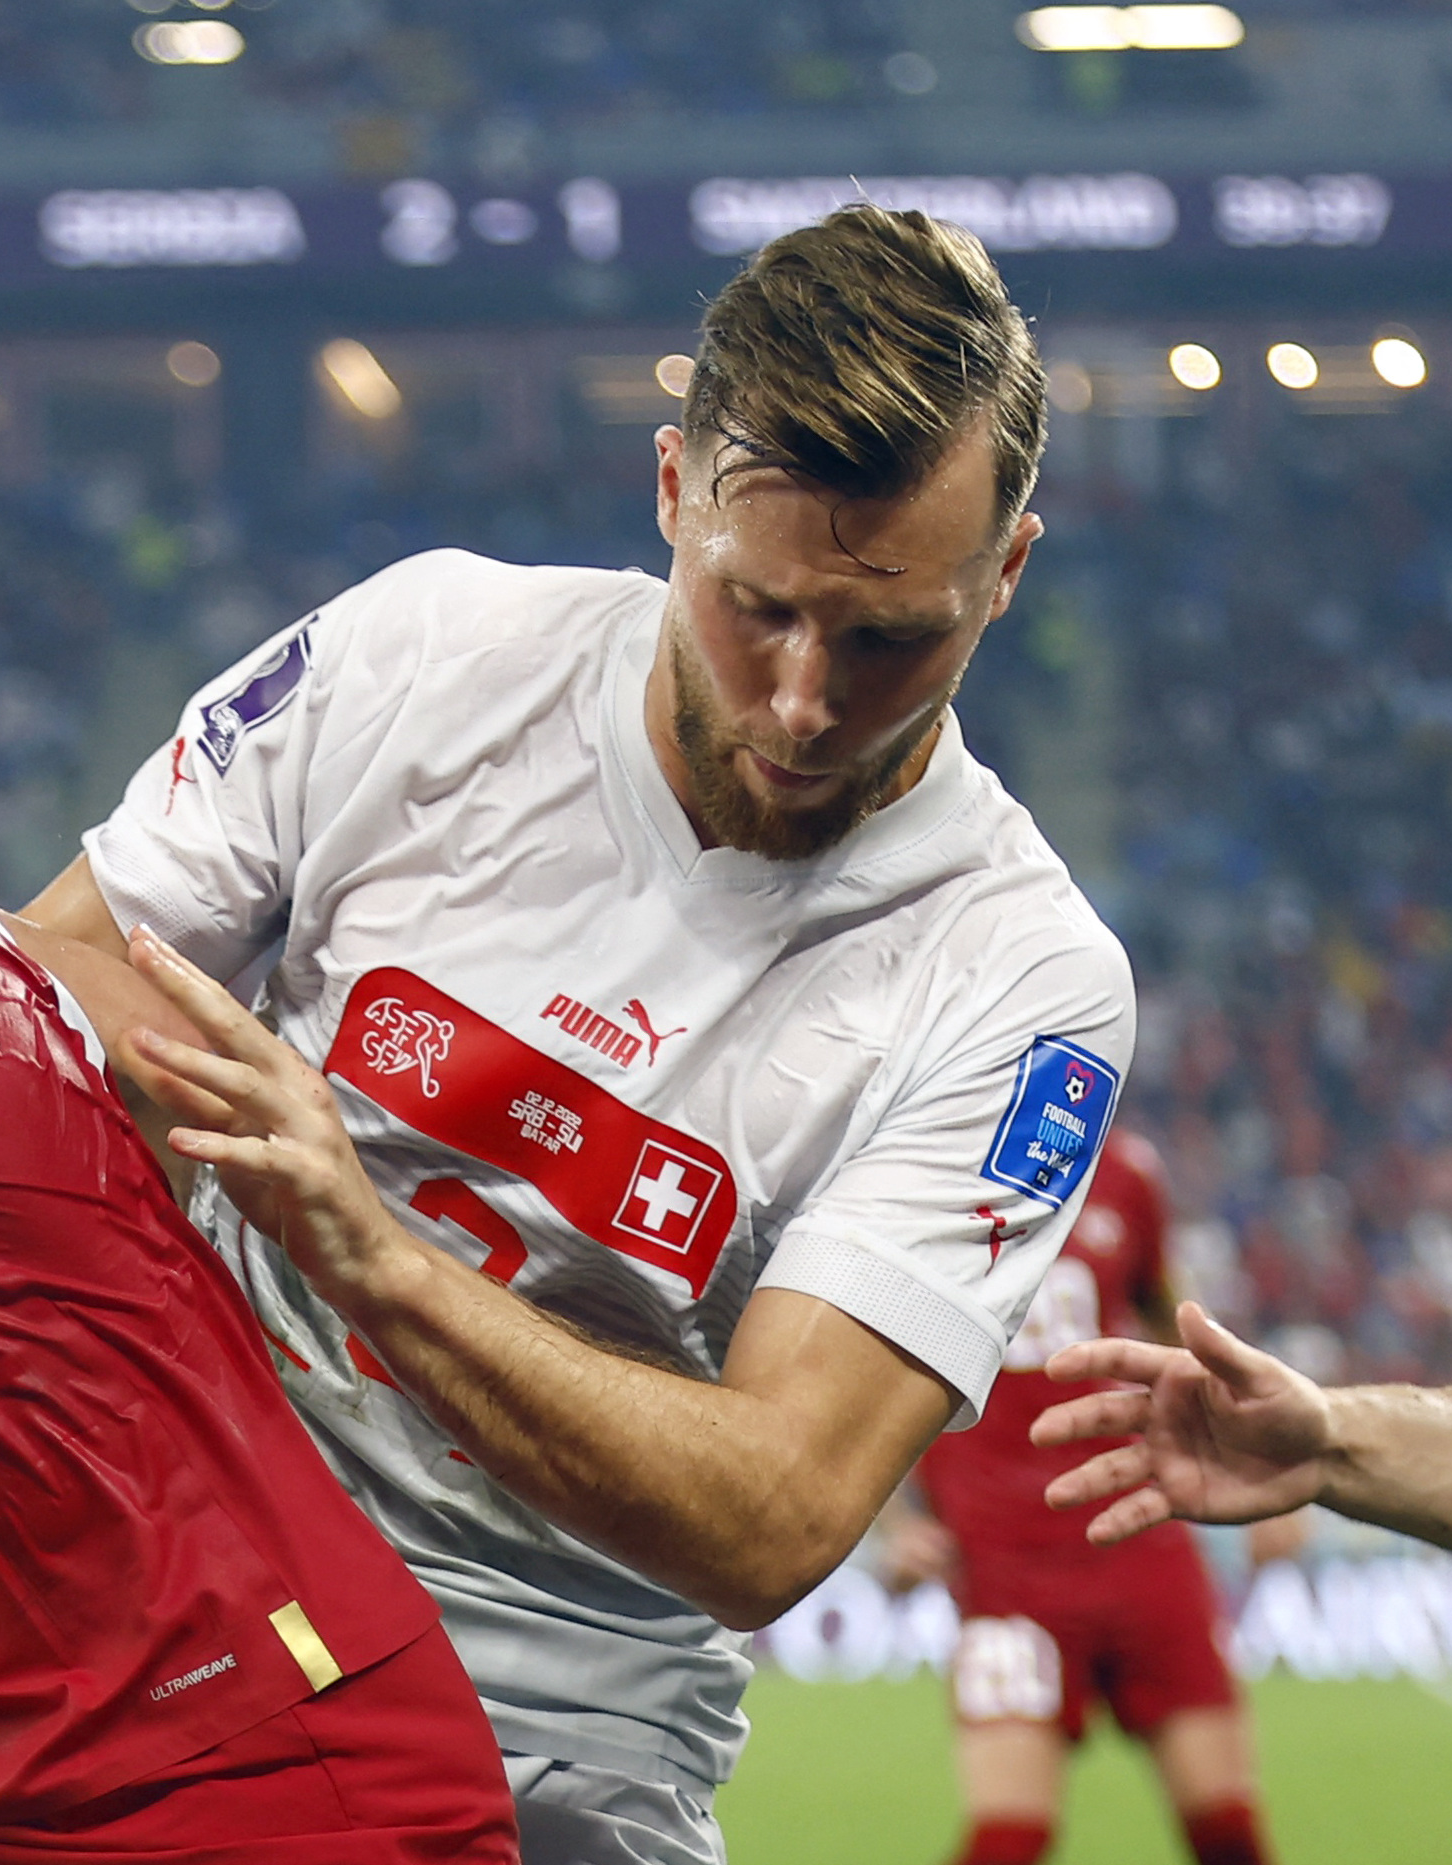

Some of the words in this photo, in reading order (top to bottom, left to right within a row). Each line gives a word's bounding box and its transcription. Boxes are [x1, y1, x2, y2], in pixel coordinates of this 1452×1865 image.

[539, 993, 643, 1069] PUMA
[507, 1099, 547, 1129] SRB
[555, 1123, 584, 1154] SUI
[520, 1123, 561, 1155] QATAR
[1036, 1118, 1084, 1157] UNITES
[1042, 1102, 1087, 1138] FOOTBALL
[1026, 1141, 1048, 1162] the
[150, 1653, 237, 1701] ULTRAWEAVE
